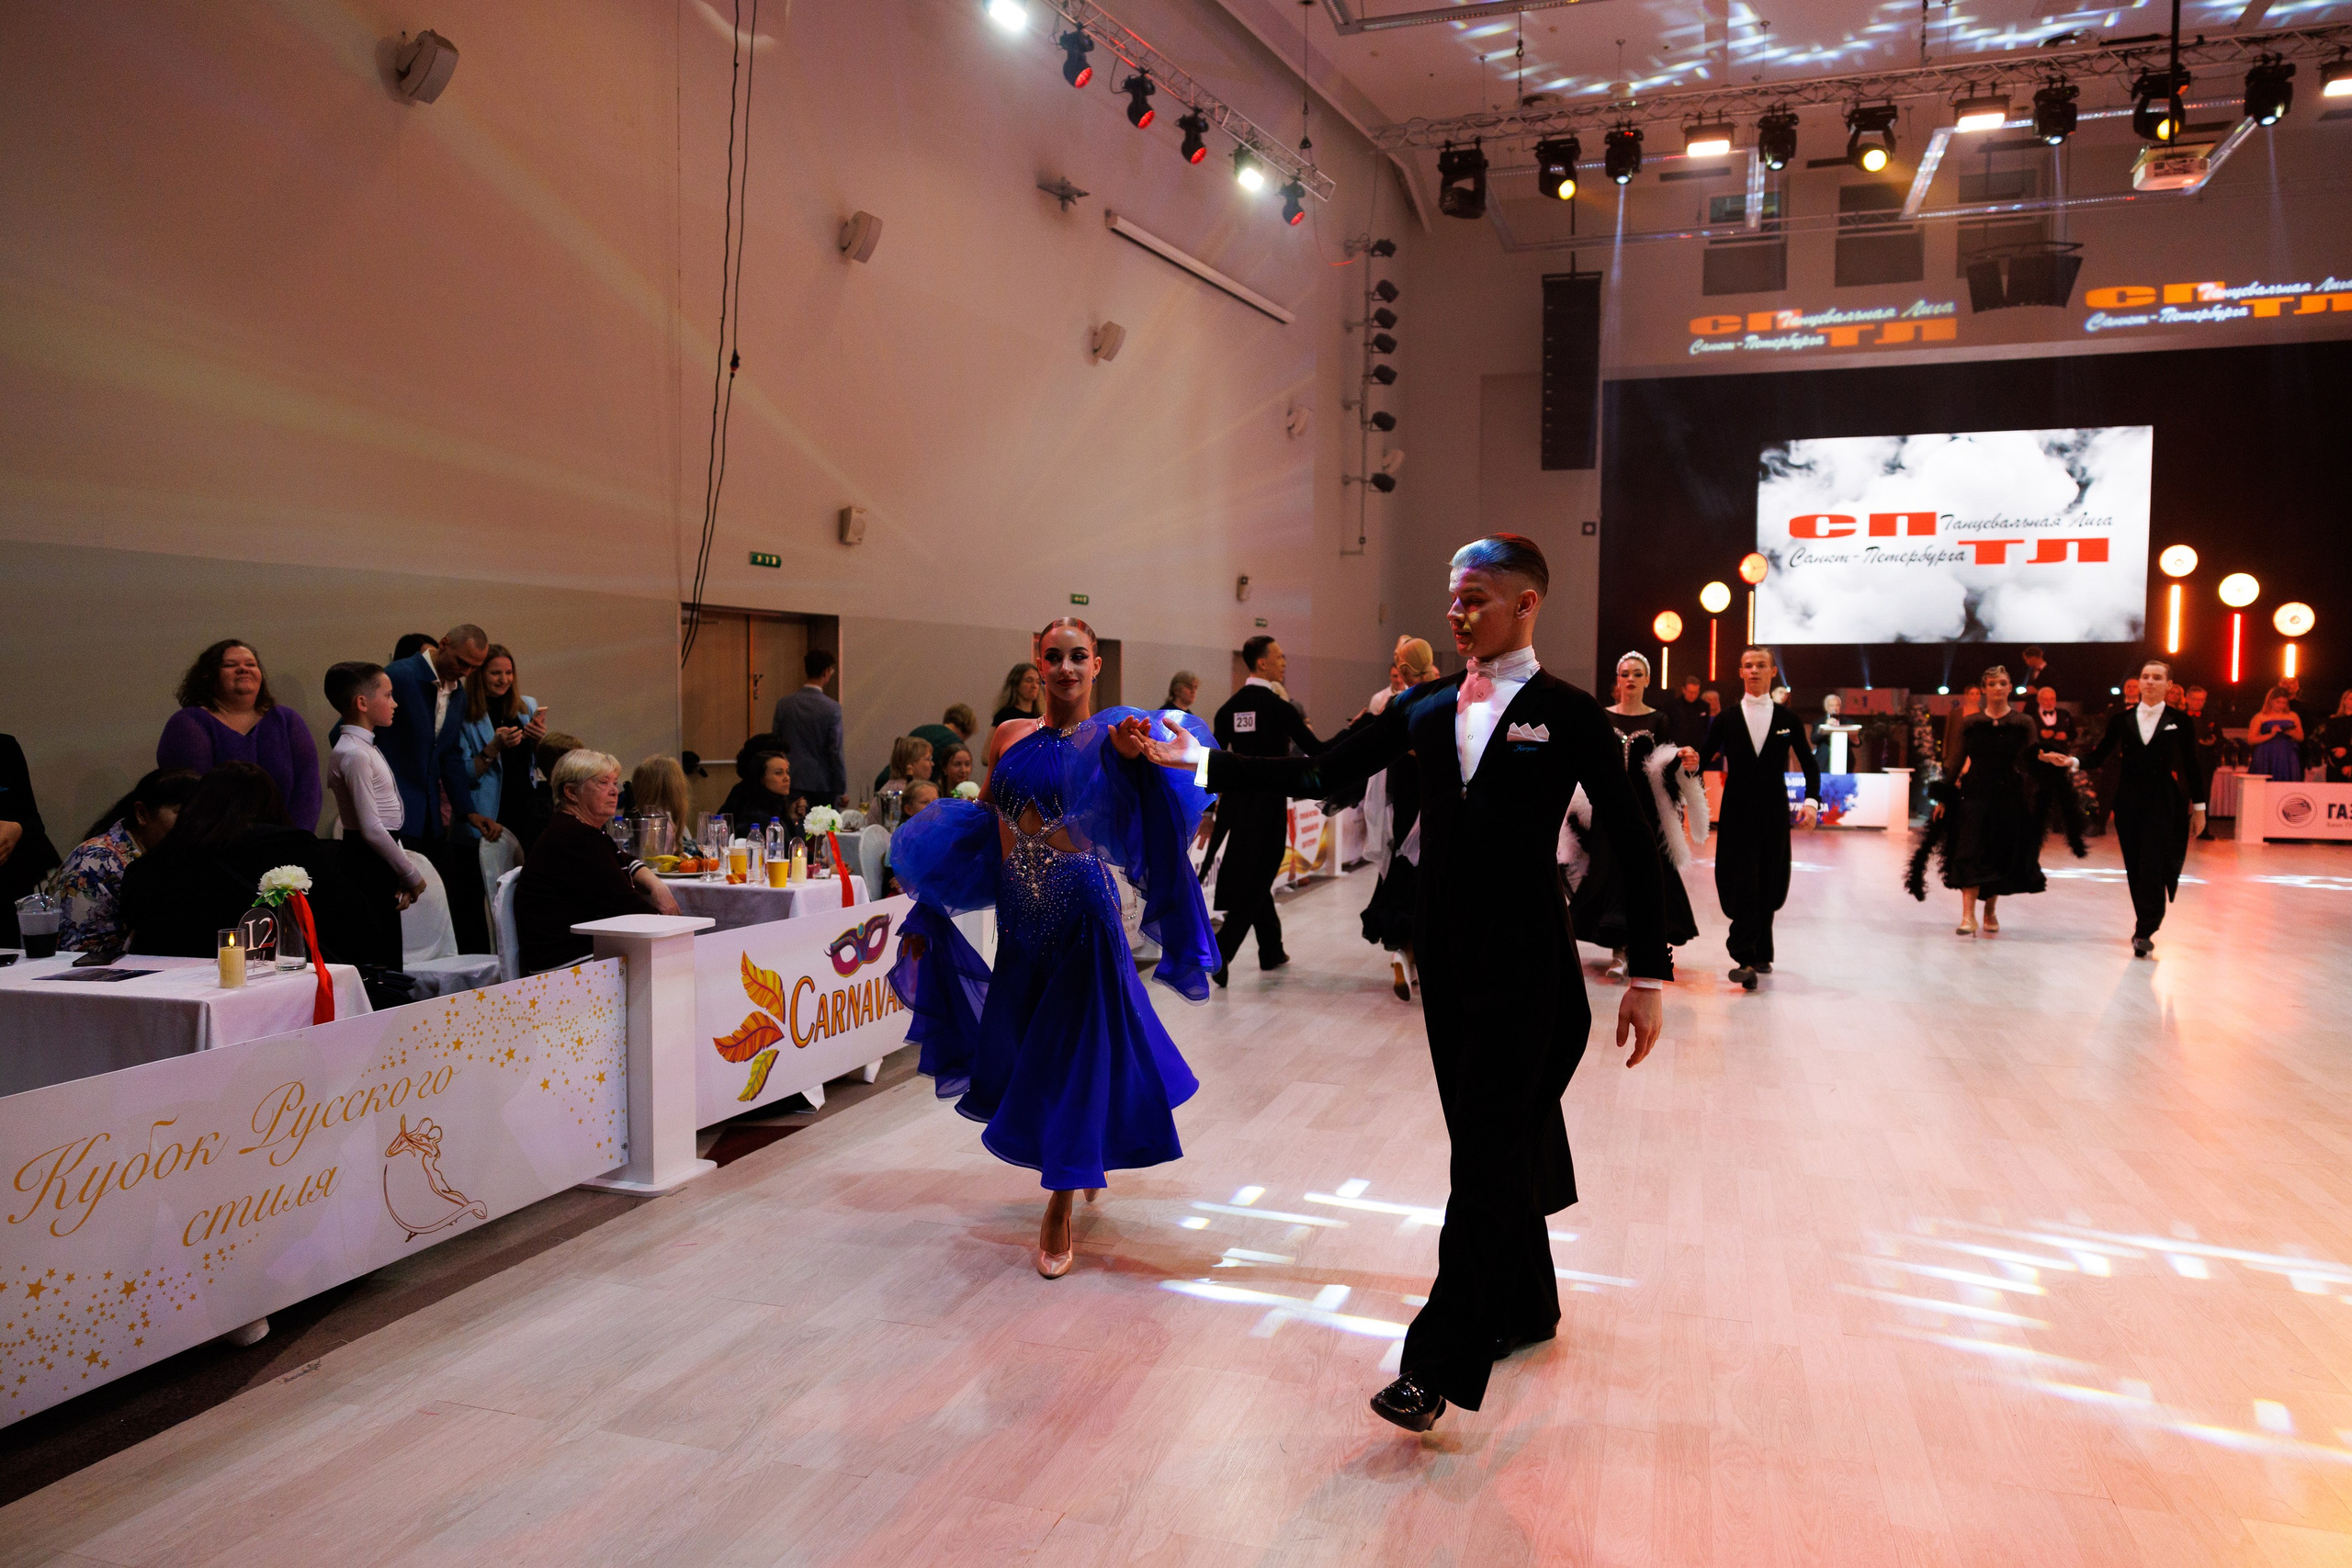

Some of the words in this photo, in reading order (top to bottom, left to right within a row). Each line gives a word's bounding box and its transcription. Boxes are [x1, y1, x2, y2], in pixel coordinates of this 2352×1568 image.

[2085, 281, 2225, 309] СП
[1690, 309, 1802, 335] СП
[1816, 318, 1957, 347] ТЛ
[1789, 512, 1937, 539] СП
[1940, 513, 2062, 533] Танцевальная
[2069, 512, 2113, 528] Лига
[1789, 545, 1966, 568] Санкт-Петербурга
[1958, 537, 2109, 565] ТЛ
[1237, 716, 1253, 728] 230
[2328, 804, 2352, 818] ГА
[244, 917, 277, 952] 12
[7, 1113, 230, 1237] Кубок
[238, 1065, 462, 1167] Русского
[182, 1166, 345, 1247] стиля
